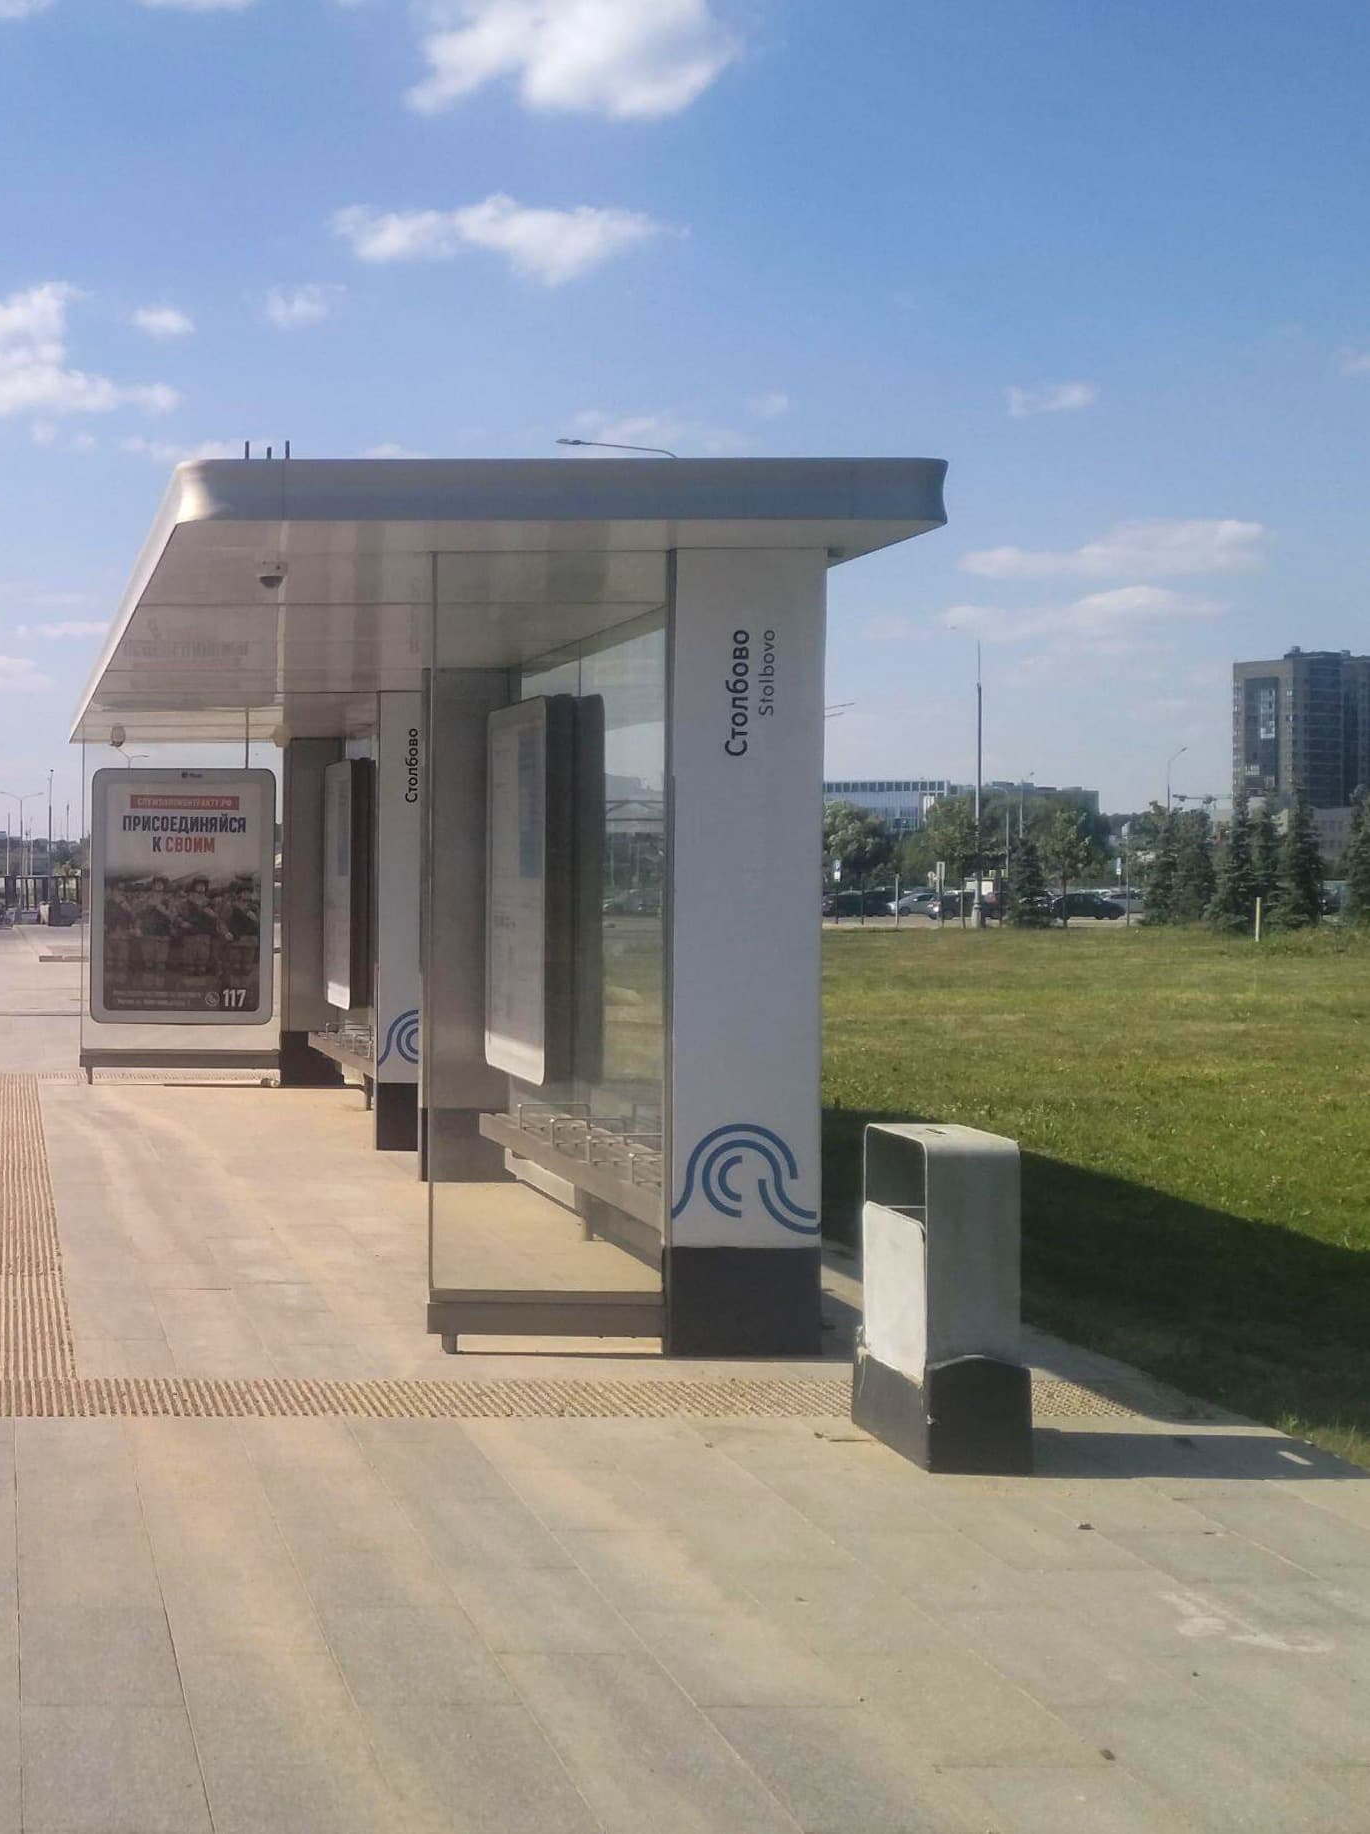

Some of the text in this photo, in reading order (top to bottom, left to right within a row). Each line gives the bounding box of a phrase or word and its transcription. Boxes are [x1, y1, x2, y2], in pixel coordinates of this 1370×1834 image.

[725, 629, 749, 756] Столбово
[758, 629, 775, 717] Stolbovo
[405, 728, 418, 803] Столбово
[122, 813, 247, 834] ПРИСОЕДИНЯЙСЯ
[152, 836, 215, 854] К СВОИМ
[222, 988, 247, 1008] 117
